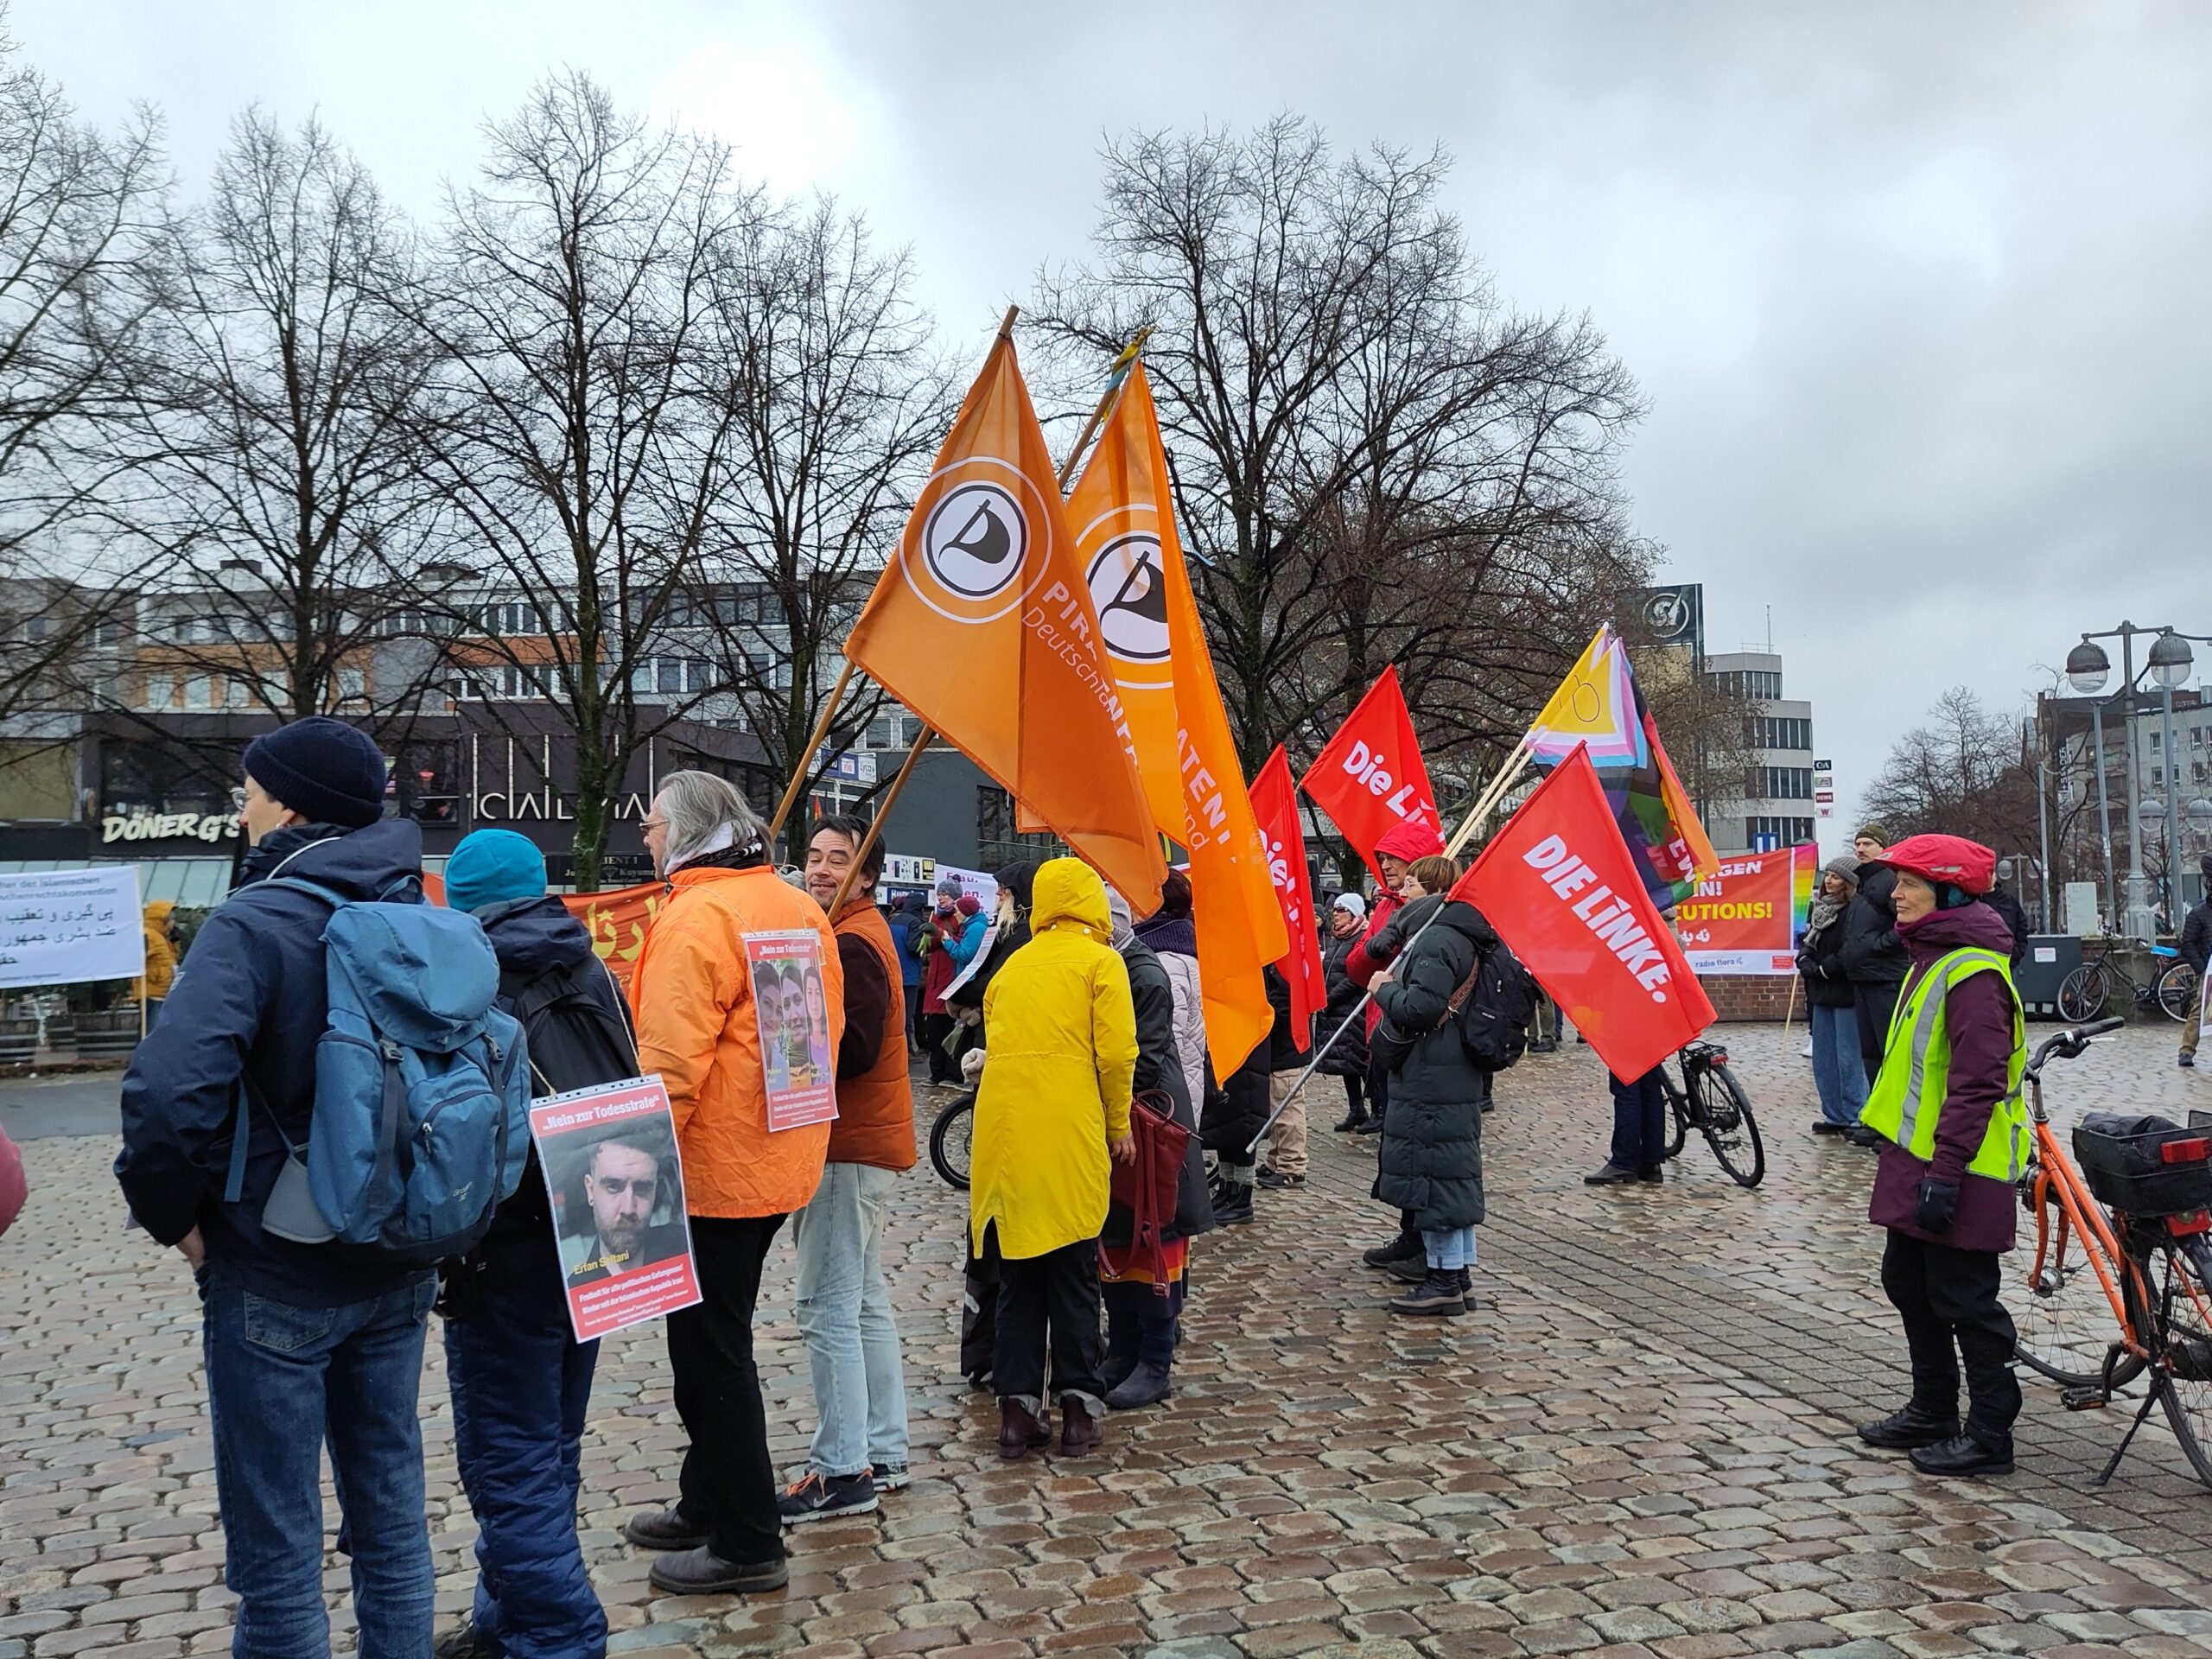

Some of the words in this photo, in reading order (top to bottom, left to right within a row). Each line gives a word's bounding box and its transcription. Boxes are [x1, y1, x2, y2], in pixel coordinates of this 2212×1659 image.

[1342, 740, 1392, 796] Die
[102, 812, 199, 843] DÖNER
[947, 872, 978, 883] Fau.
[1522, 834, 1598, 900] DIE
[1572, 885, 1672, 1002] LINKE.
[1695, 959, 1715, 968] radio
[575, 1110, 594, 1123] zur
